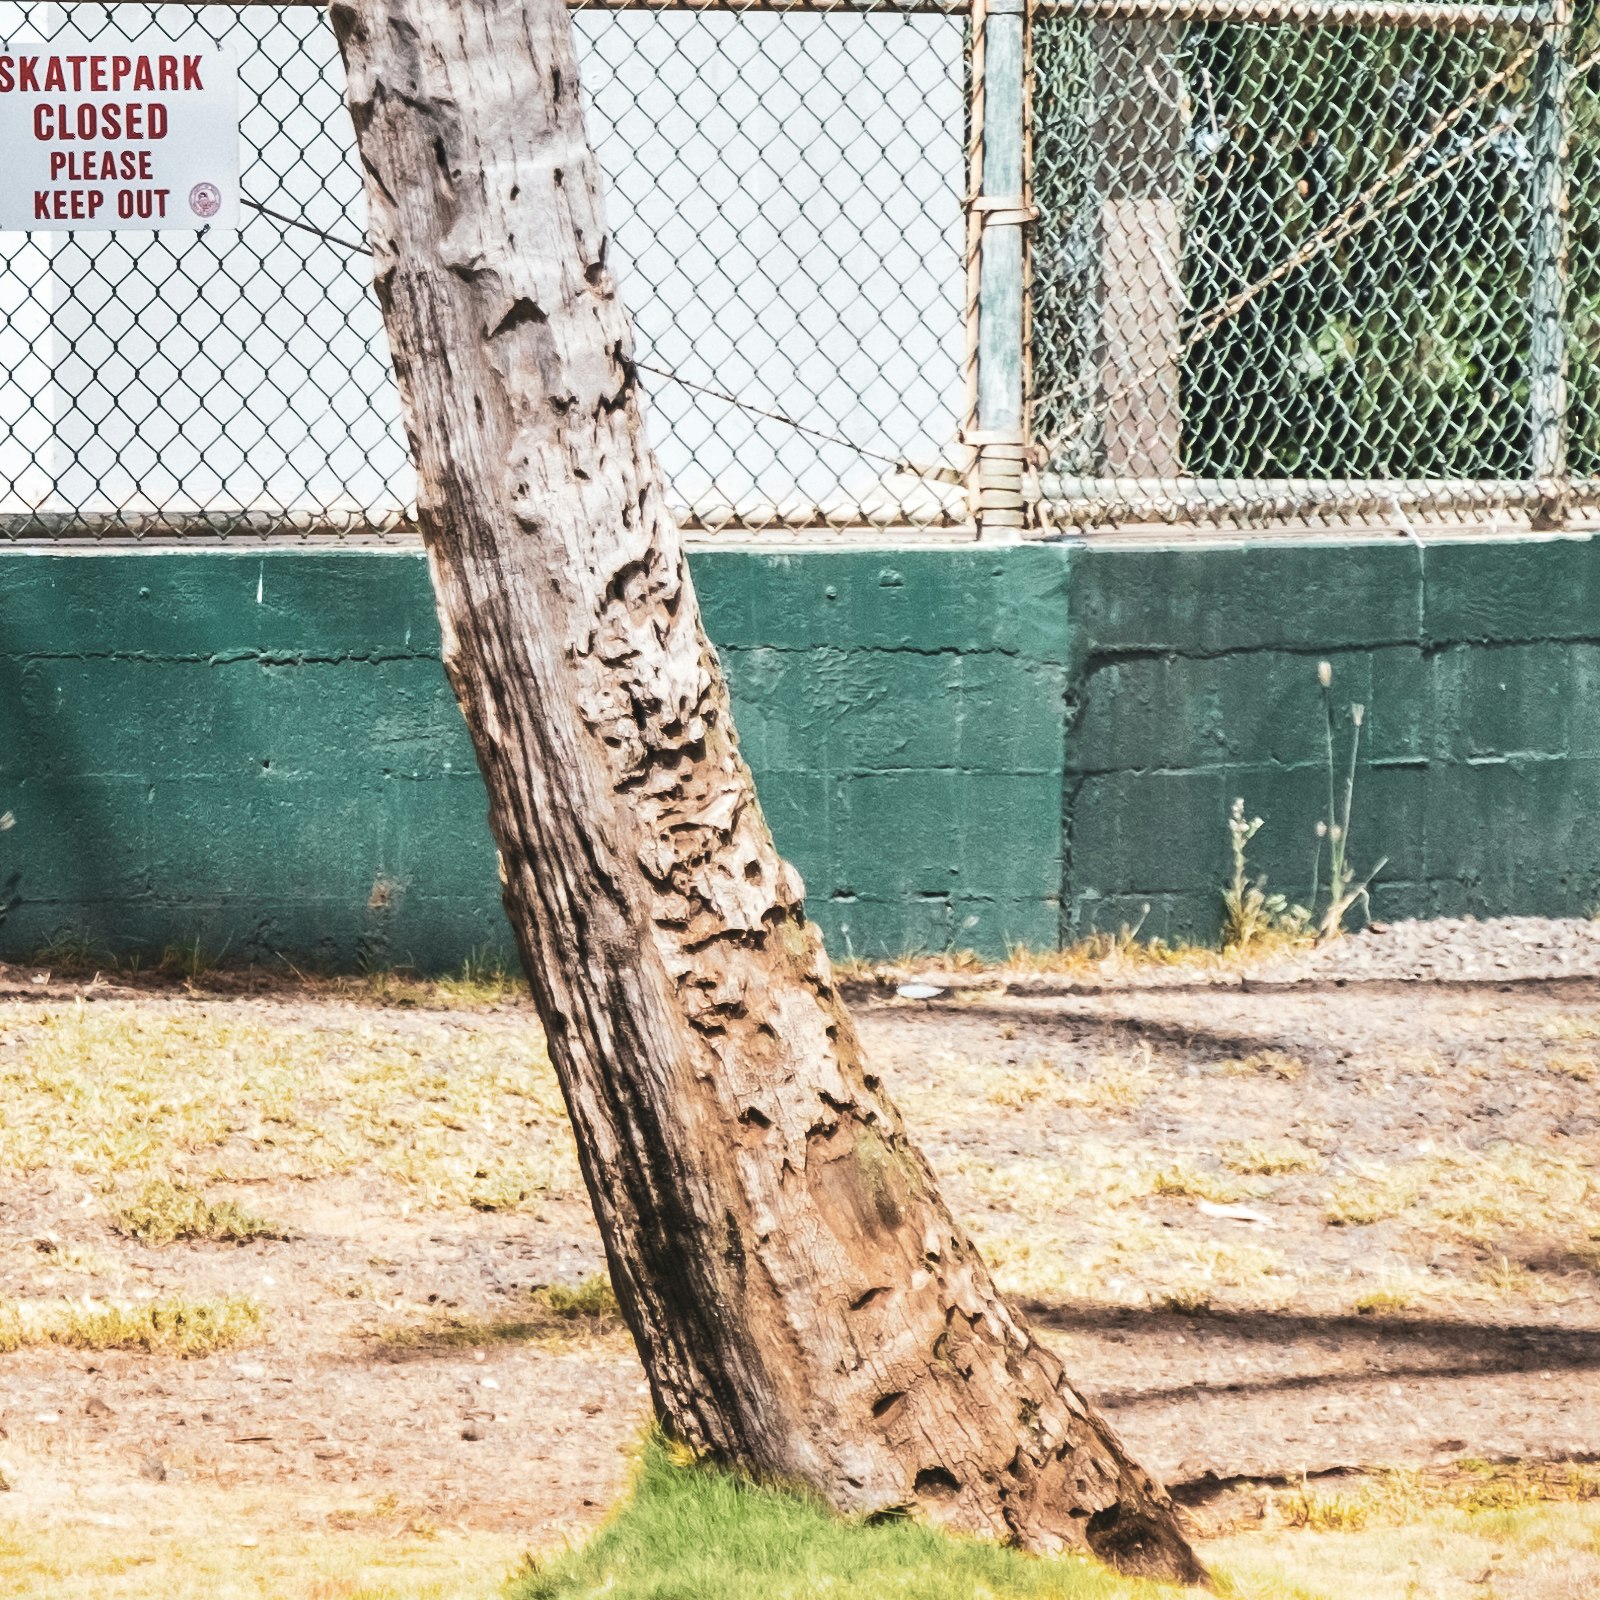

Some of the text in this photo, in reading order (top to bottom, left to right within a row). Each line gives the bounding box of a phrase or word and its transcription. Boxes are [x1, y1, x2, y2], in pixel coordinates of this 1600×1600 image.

[33, 103, 168, 141] CLOSED
[50, 150, 153, 180] PLEASE
[34, 190, 104, 219] KEEP
[117, 189, 170, 219] OUT
